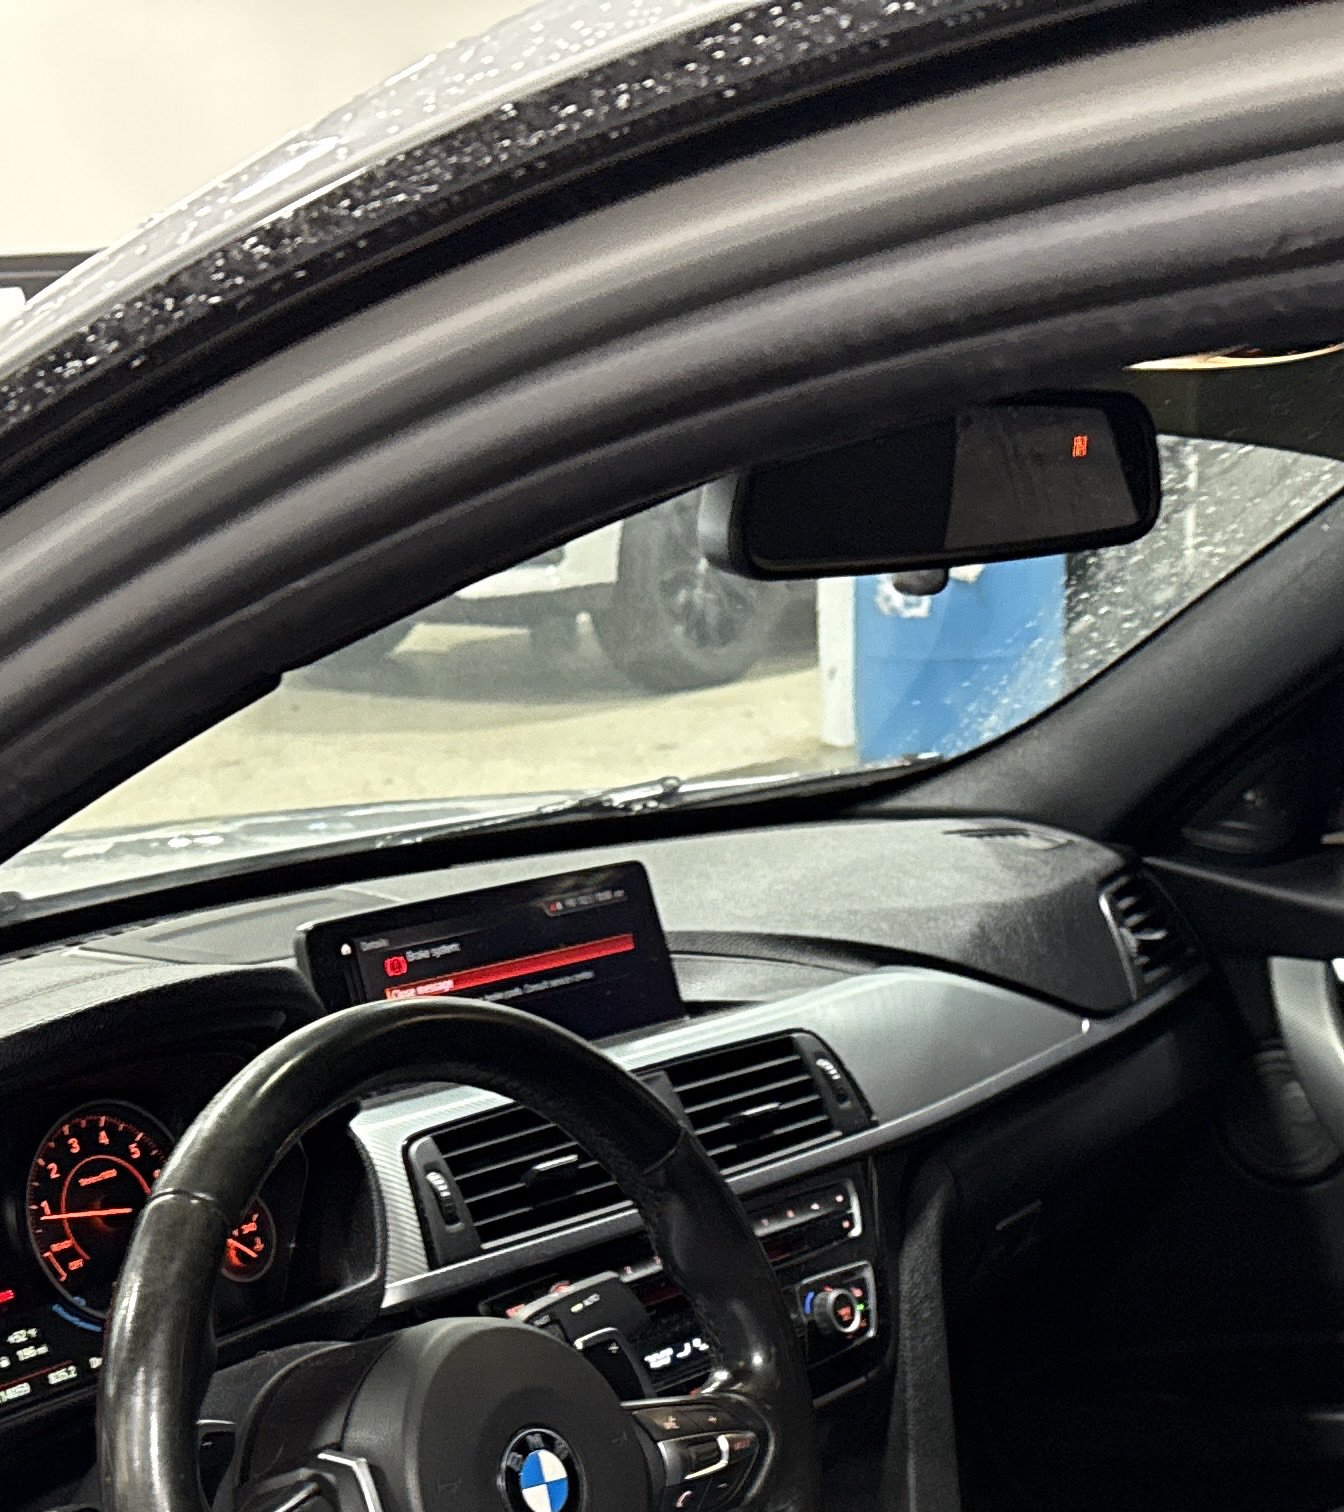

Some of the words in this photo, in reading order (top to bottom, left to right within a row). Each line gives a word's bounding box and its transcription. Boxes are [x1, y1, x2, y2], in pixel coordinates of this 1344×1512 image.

[67, 1137, 81, 1154] 3
[98, 1130, 110, 1145] 4
[128, 1142, 141, 1159] 5
[47, 1162, 61, 1179] 2
[506, 1432, 573, 1472] BMW
